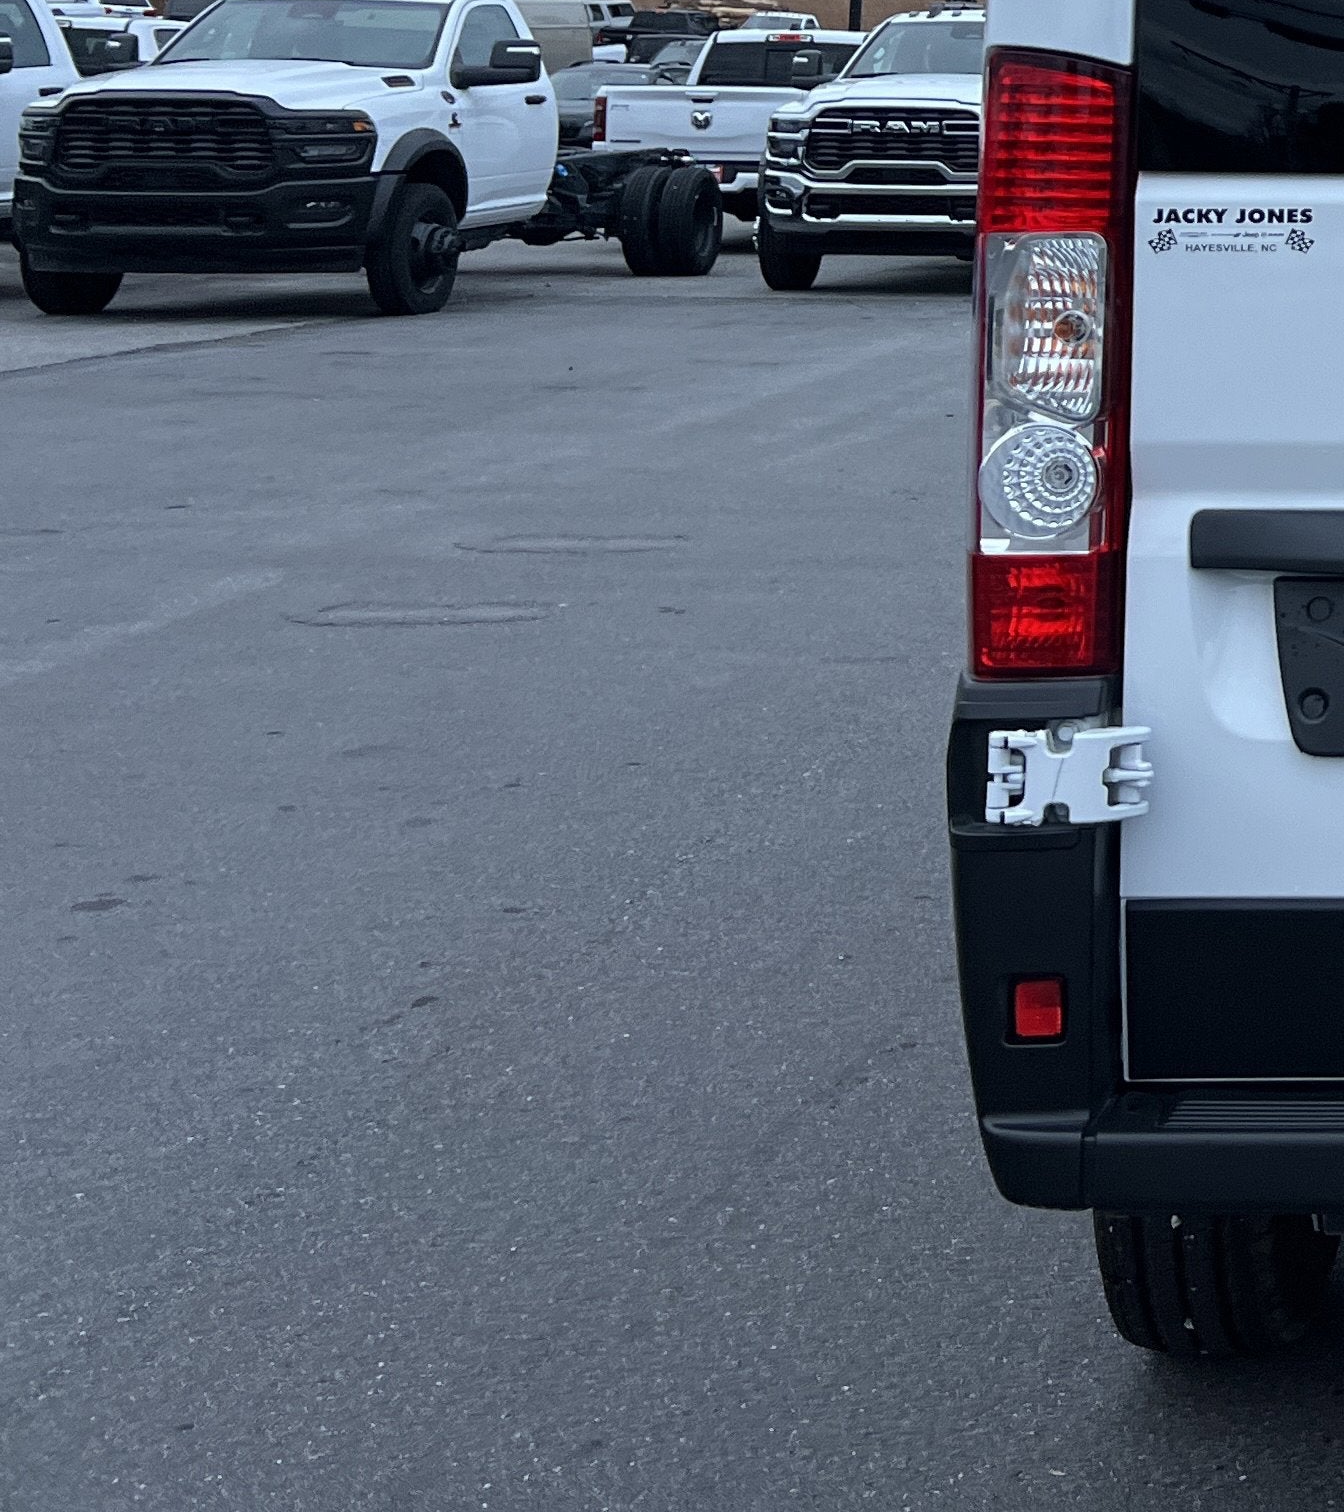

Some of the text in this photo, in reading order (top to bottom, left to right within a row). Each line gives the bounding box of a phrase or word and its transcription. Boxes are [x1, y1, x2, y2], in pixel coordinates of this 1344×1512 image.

[852, 120, 940, 134] RAM
[1153, 208, 1313, 224] JACKY JONES
[1261, 243, 1277, 252] NC
